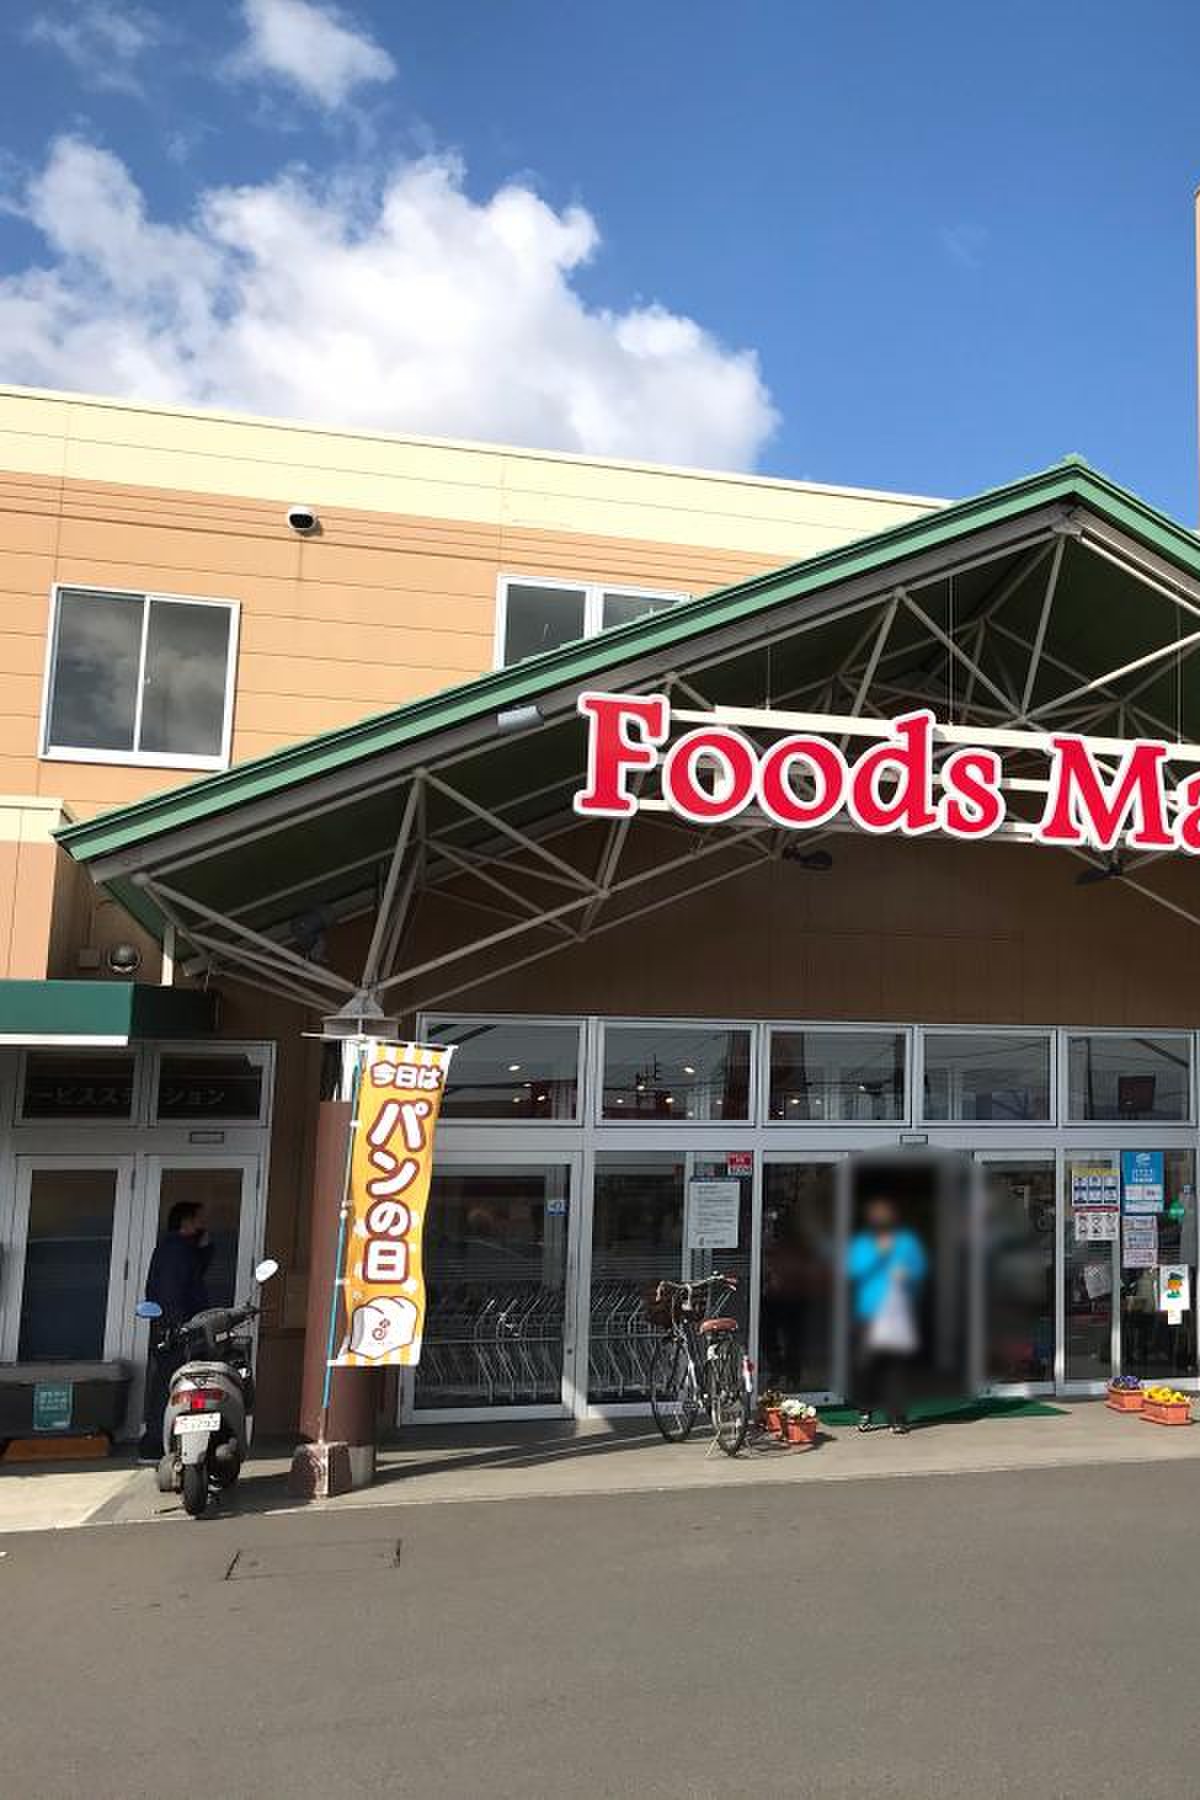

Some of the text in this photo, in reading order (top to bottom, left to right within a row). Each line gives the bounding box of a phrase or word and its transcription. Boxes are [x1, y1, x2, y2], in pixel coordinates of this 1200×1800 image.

[575, 693, 1006, 838] Foods
[372, 1062, 442, 1090] 今日は
[364, 1100, 432, 1284] パンの日
